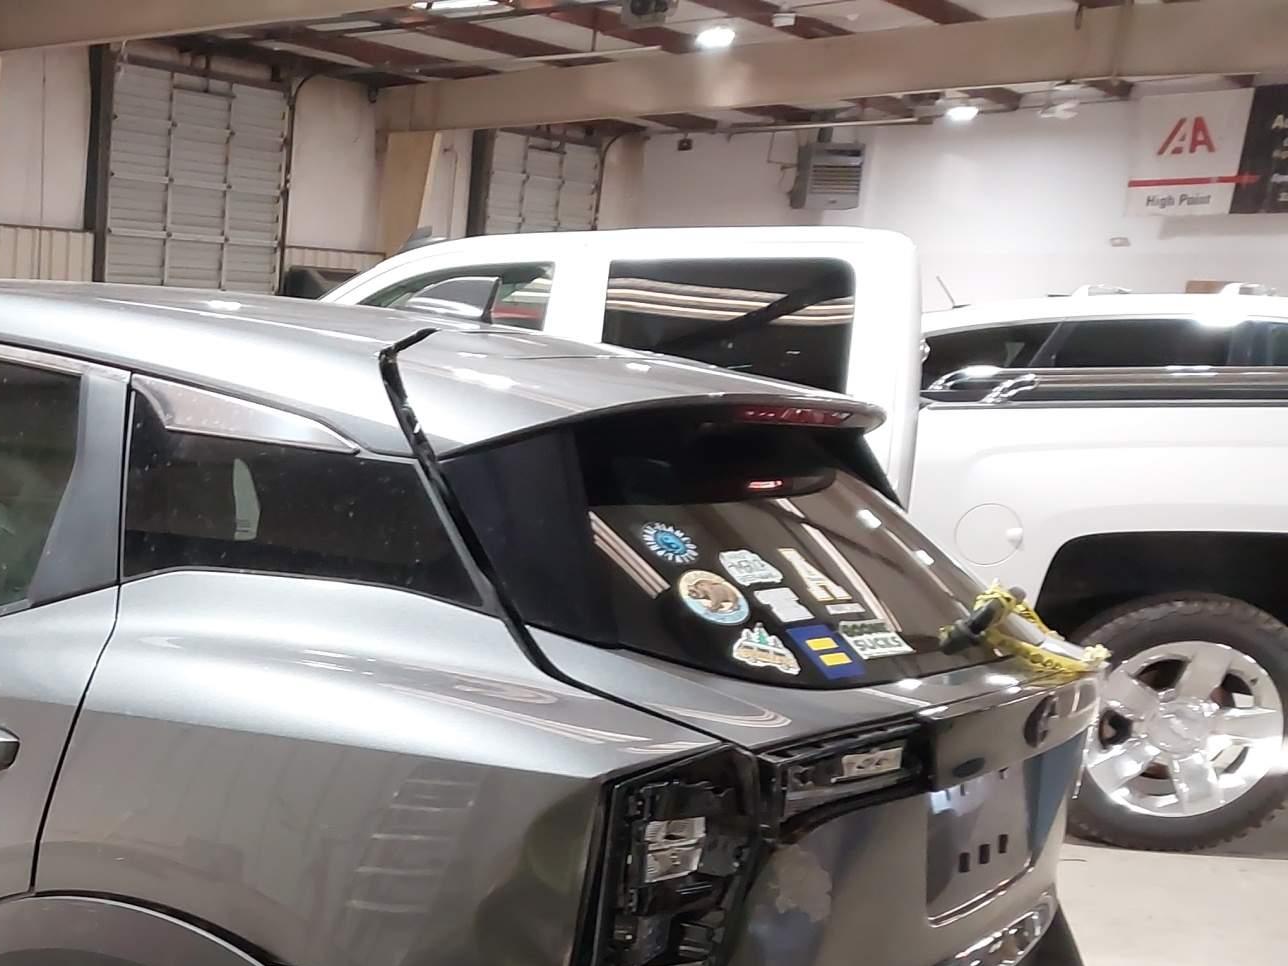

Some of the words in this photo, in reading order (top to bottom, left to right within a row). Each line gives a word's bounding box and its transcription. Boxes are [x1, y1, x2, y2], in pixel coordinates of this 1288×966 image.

[1145, 194, 1175, 209] High
[1178, 192, 1212, 207] Point
[853, 636, 903, 651] SUCKS
